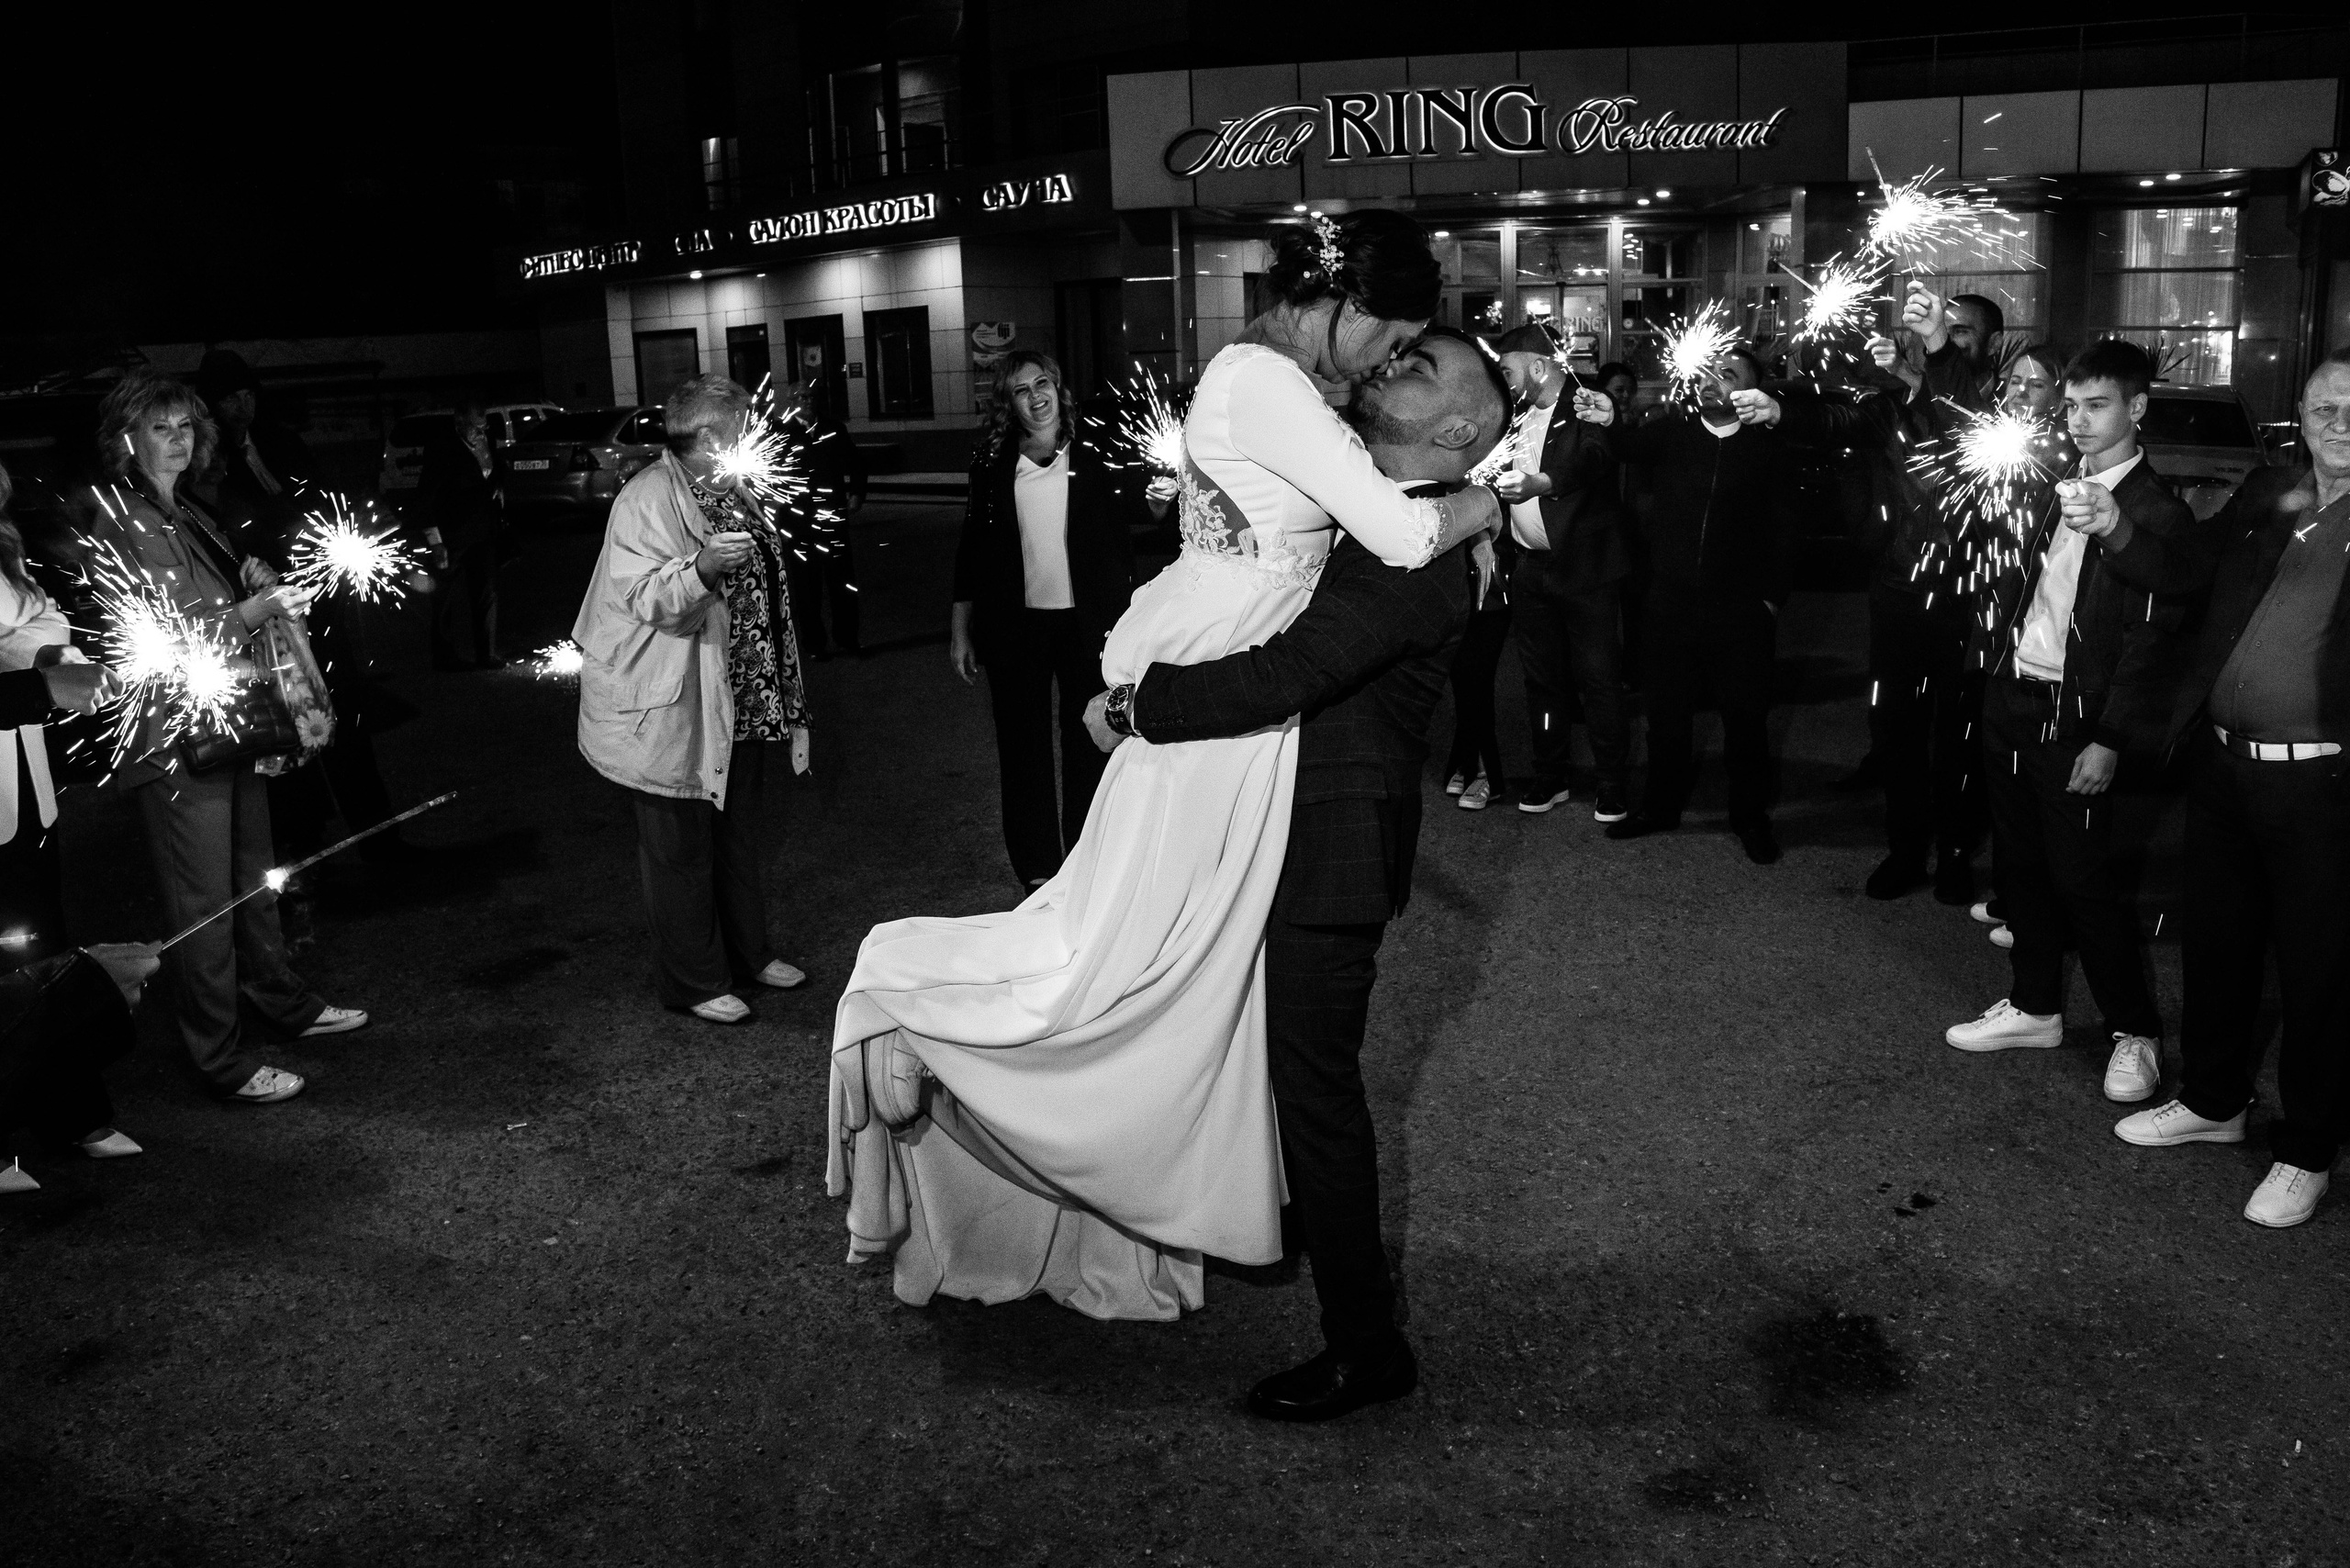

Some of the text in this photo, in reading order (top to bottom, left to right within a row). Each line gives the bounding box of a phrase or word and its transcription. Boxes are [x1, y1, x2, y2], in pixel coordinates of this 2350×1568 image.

[1164, 84, 1791, 177] Hotel RING Restaurant
[823, 193, 934, 234] КРАСОТЫ
